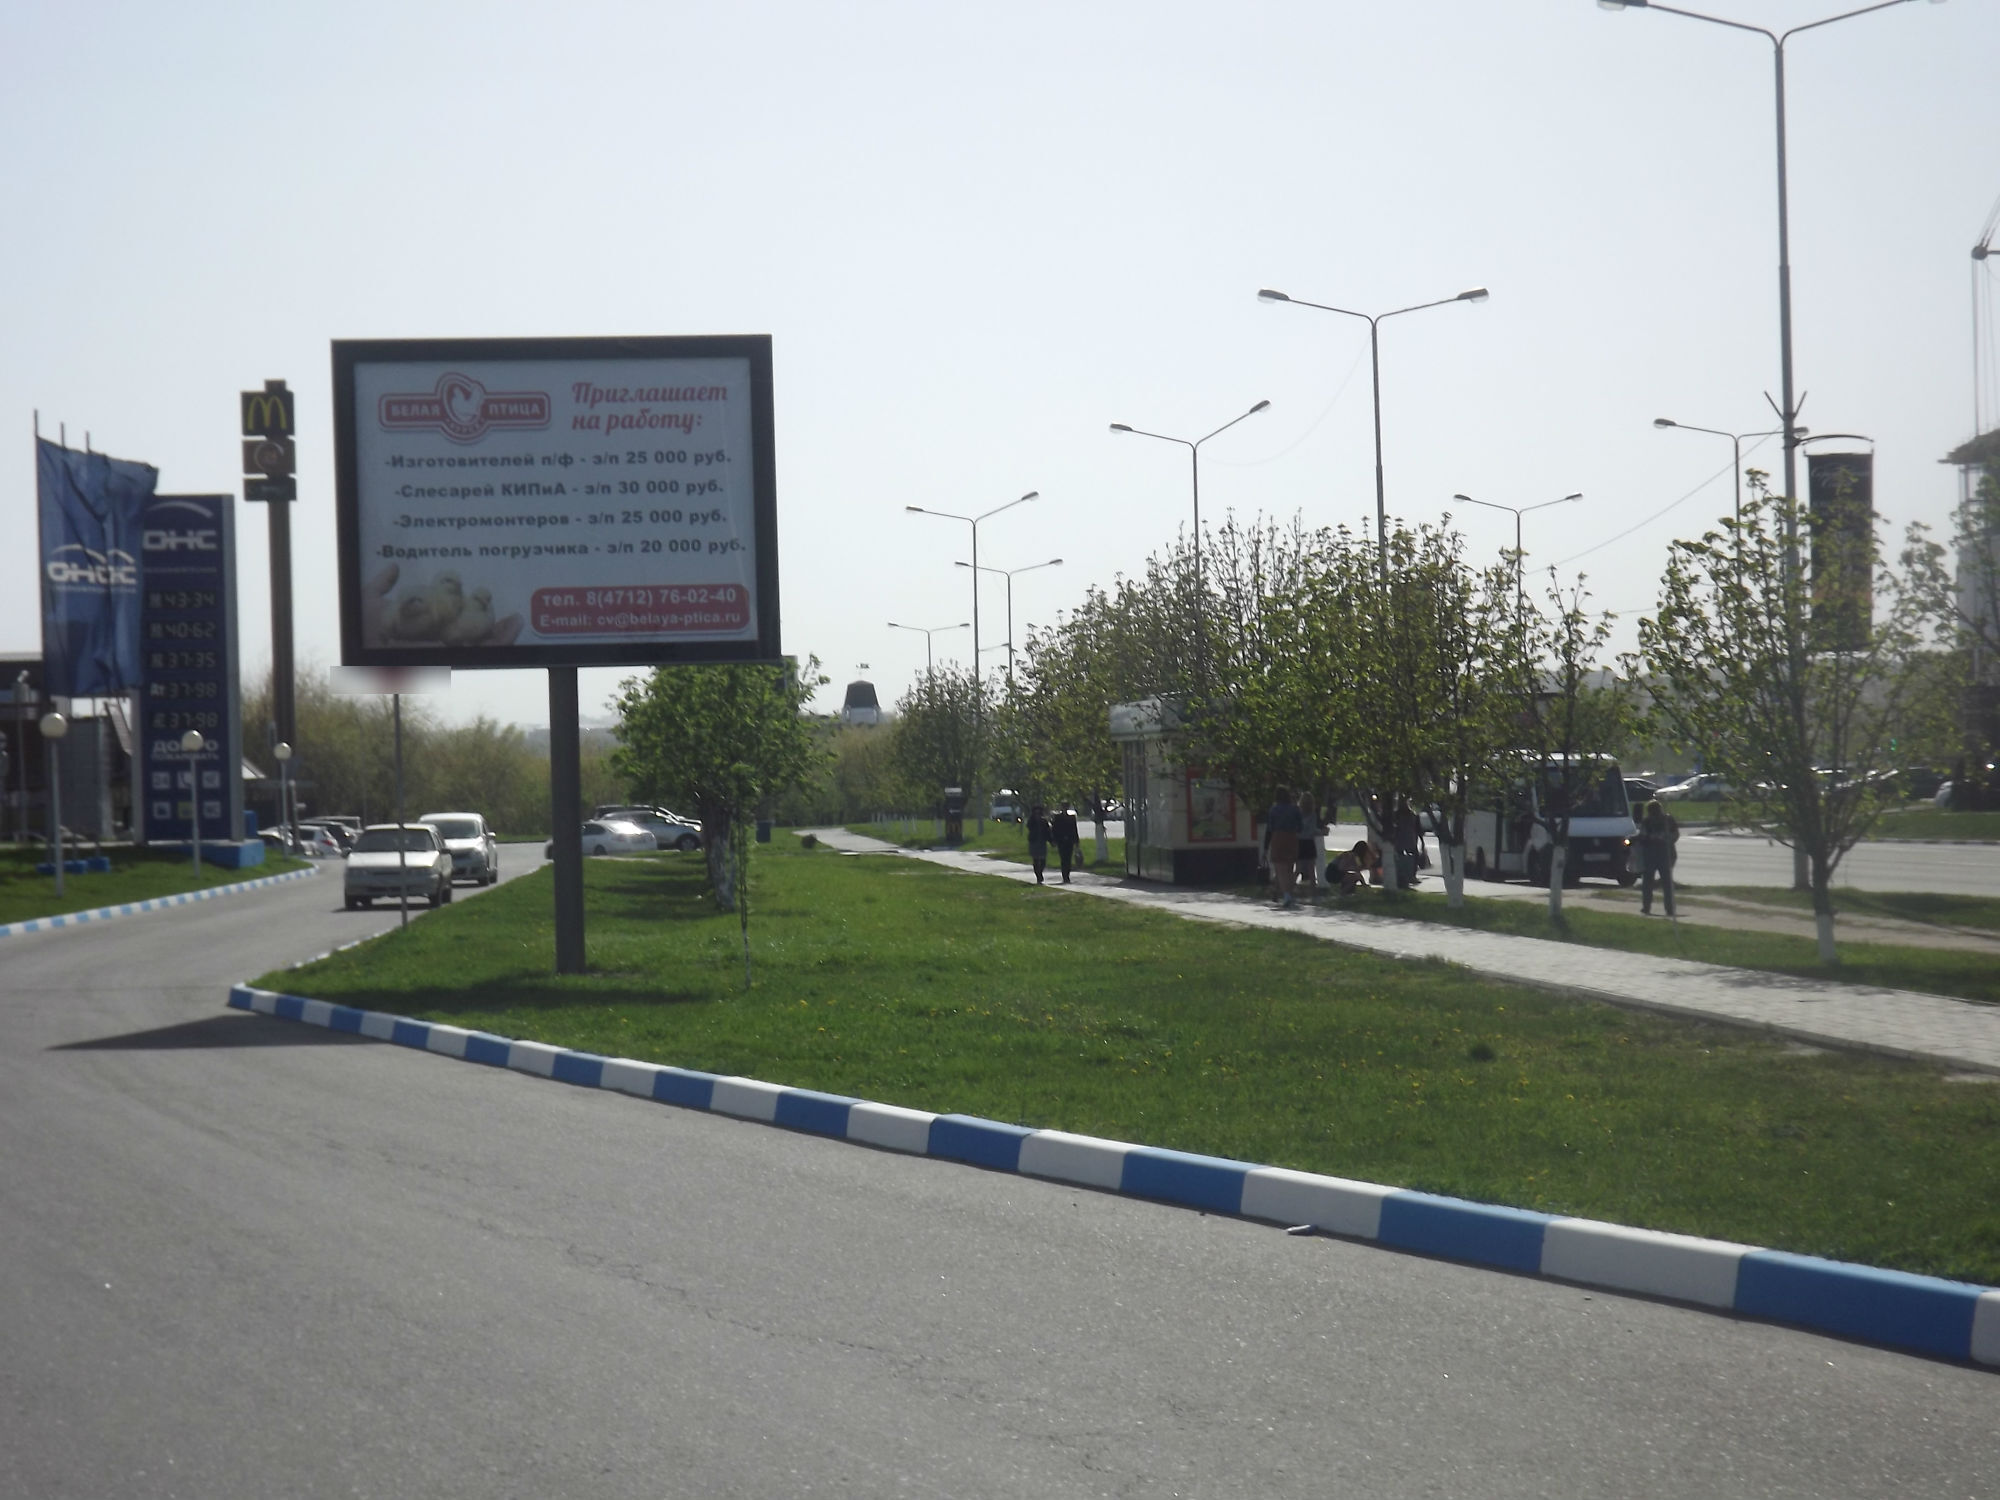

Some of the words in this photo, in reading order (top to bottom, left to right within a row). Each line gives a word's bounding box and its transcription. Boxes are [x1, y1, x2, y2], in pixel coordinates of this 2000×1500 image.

[571, 381, 729, 408] Приглашает
[391, 402, 441, 417] БЕЛАЯ
[488, 400, 541, 417] ПТИЦА
[571, 412, 601, 431] на
[605, 407, 703, 435] работу:
[541, 451, 574, 469] п/ф
[592, 451, 620, 465] з/п
[626, 451, 648, 465] 25
[654, 450, 687, 464] 000
[693, 449, 732, 466] руб.
[501, 482, 567, 497] КИПиА
[584, 481, 612, 495] з/п
[618, 481, 640, 494] 30
[646, 480, 680, 493] 000
[686, 479, 724, 496] руб.
[588, 511, 615, 525] з/п
[621, 511, 643, 524] 25
[649, 510, 683, 523] 000
[689, 509, 727, 526] руб.
[479, 543, 589, 560] погрузчика
[607, 541, 635, 555] з/п
[640, 540, 662, 553] 20
[668, 539, 702, 553] 000
[708, 538, 747, 555] руб.
[541, 592, 581, 607] тел.
[586, 588, 654, 608] 8(4712)
[659, 587, 737, 604] 76-02-40
[539, 613, 593, 628] E-mail:
[597, 611, 741, 628] cv@belaya-ptica.ru
[152, 740, 219, 754] ДОО
